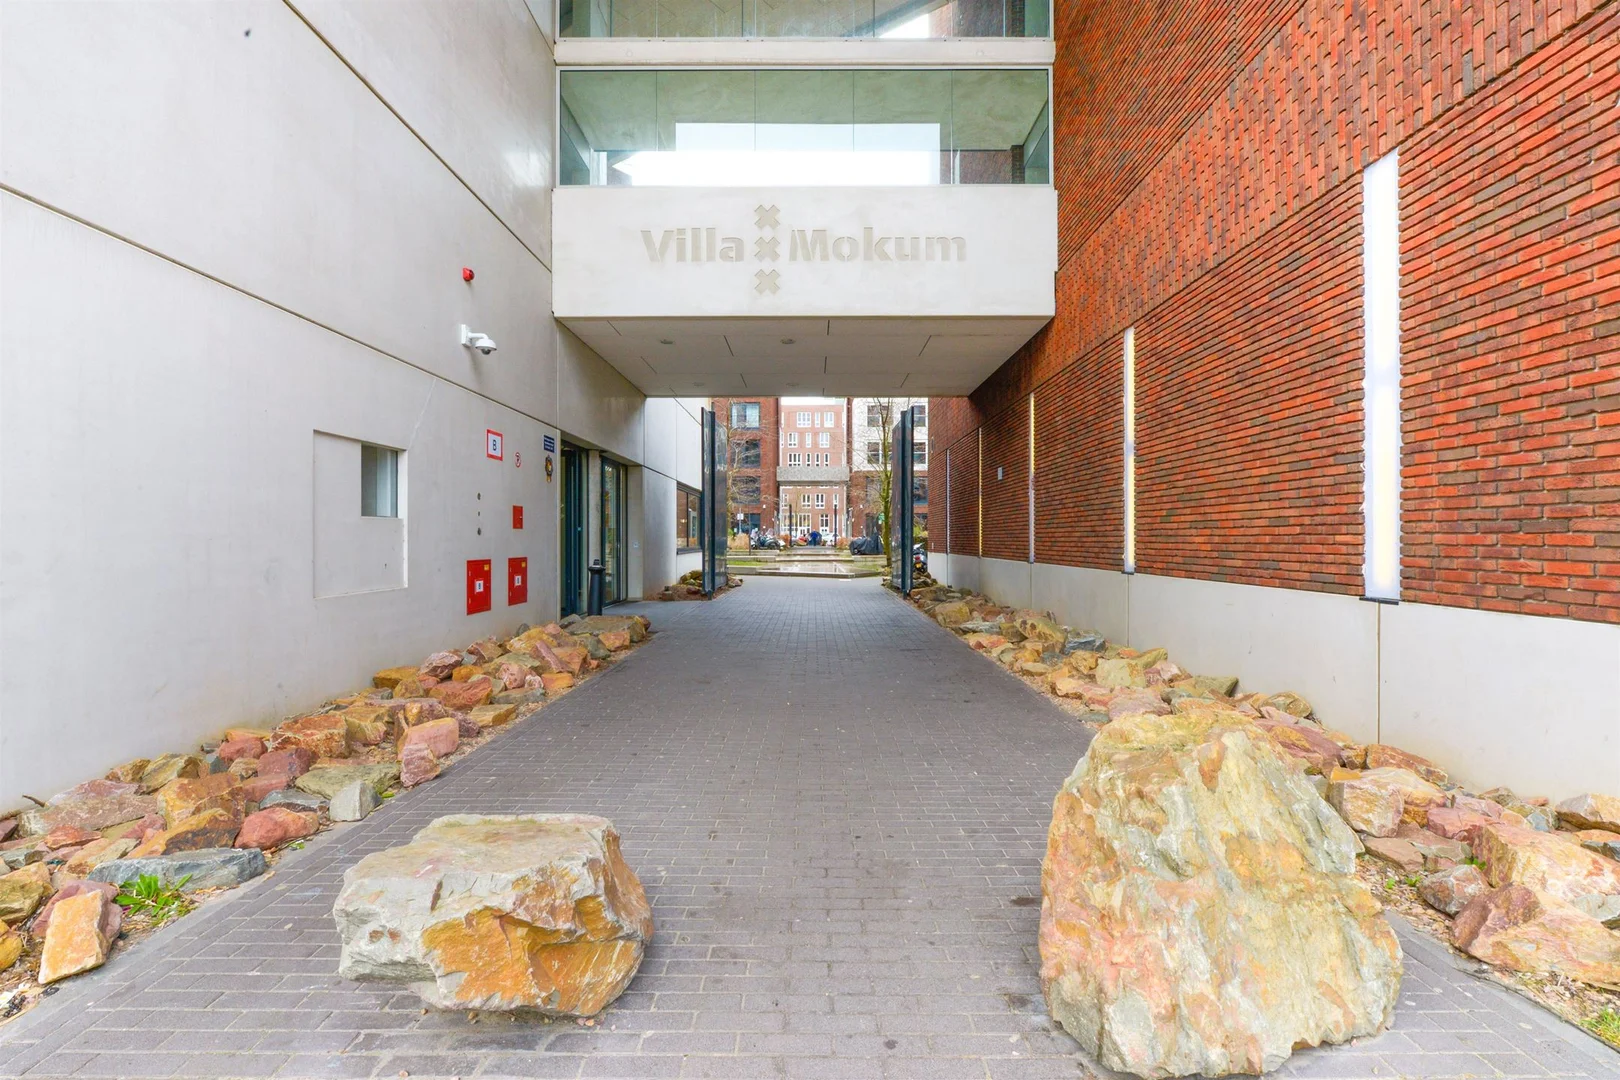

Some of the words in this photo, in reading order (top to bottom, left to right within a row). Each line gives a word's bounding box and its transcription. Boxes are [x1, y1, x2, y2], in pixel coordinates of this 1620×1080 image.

[640, 227, 745, 262] Villa
[788, 227, 967, 262] Mokum
[492, 439, 497, 451] B
